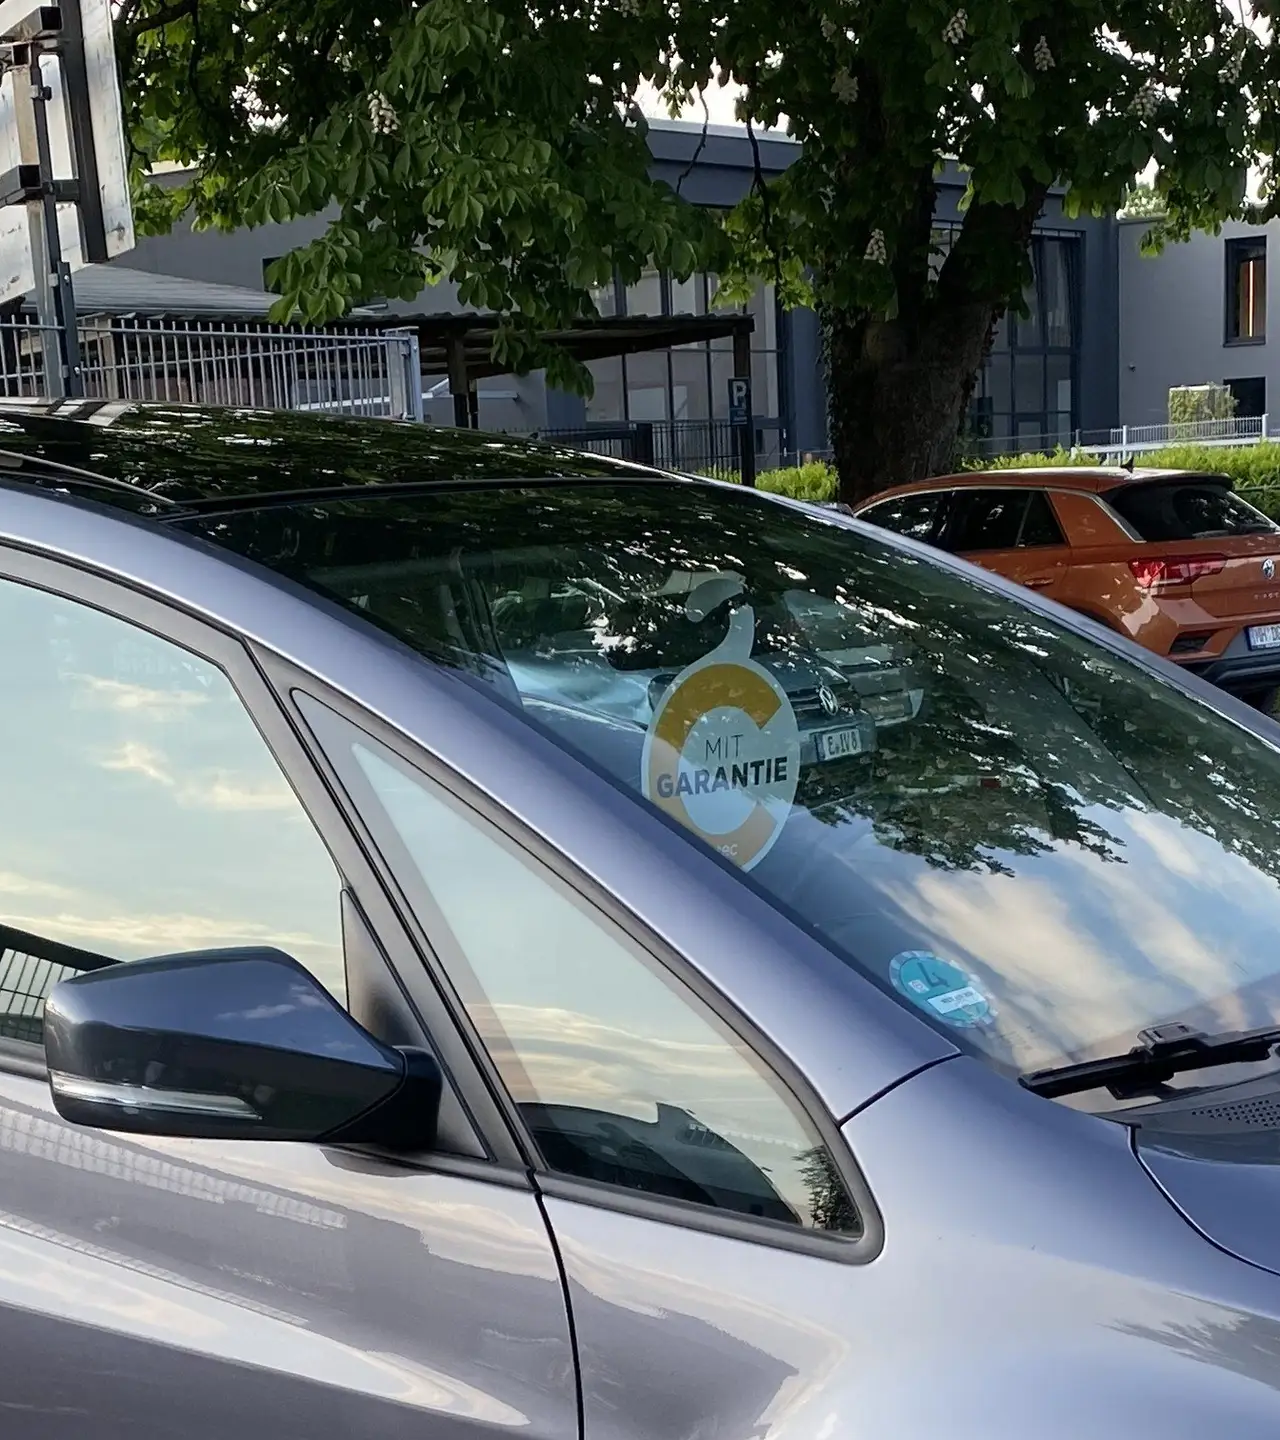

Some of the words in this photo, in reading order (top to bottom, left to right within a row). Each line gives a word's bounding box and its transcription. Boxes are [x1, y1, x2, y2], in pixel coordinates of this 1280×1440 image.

[732, 380, 747, 407] P
[705, 734, 744, 762] MIT
[656, 756, 788, 799] GARANTIE
[916, 961, 951, 988] 4
